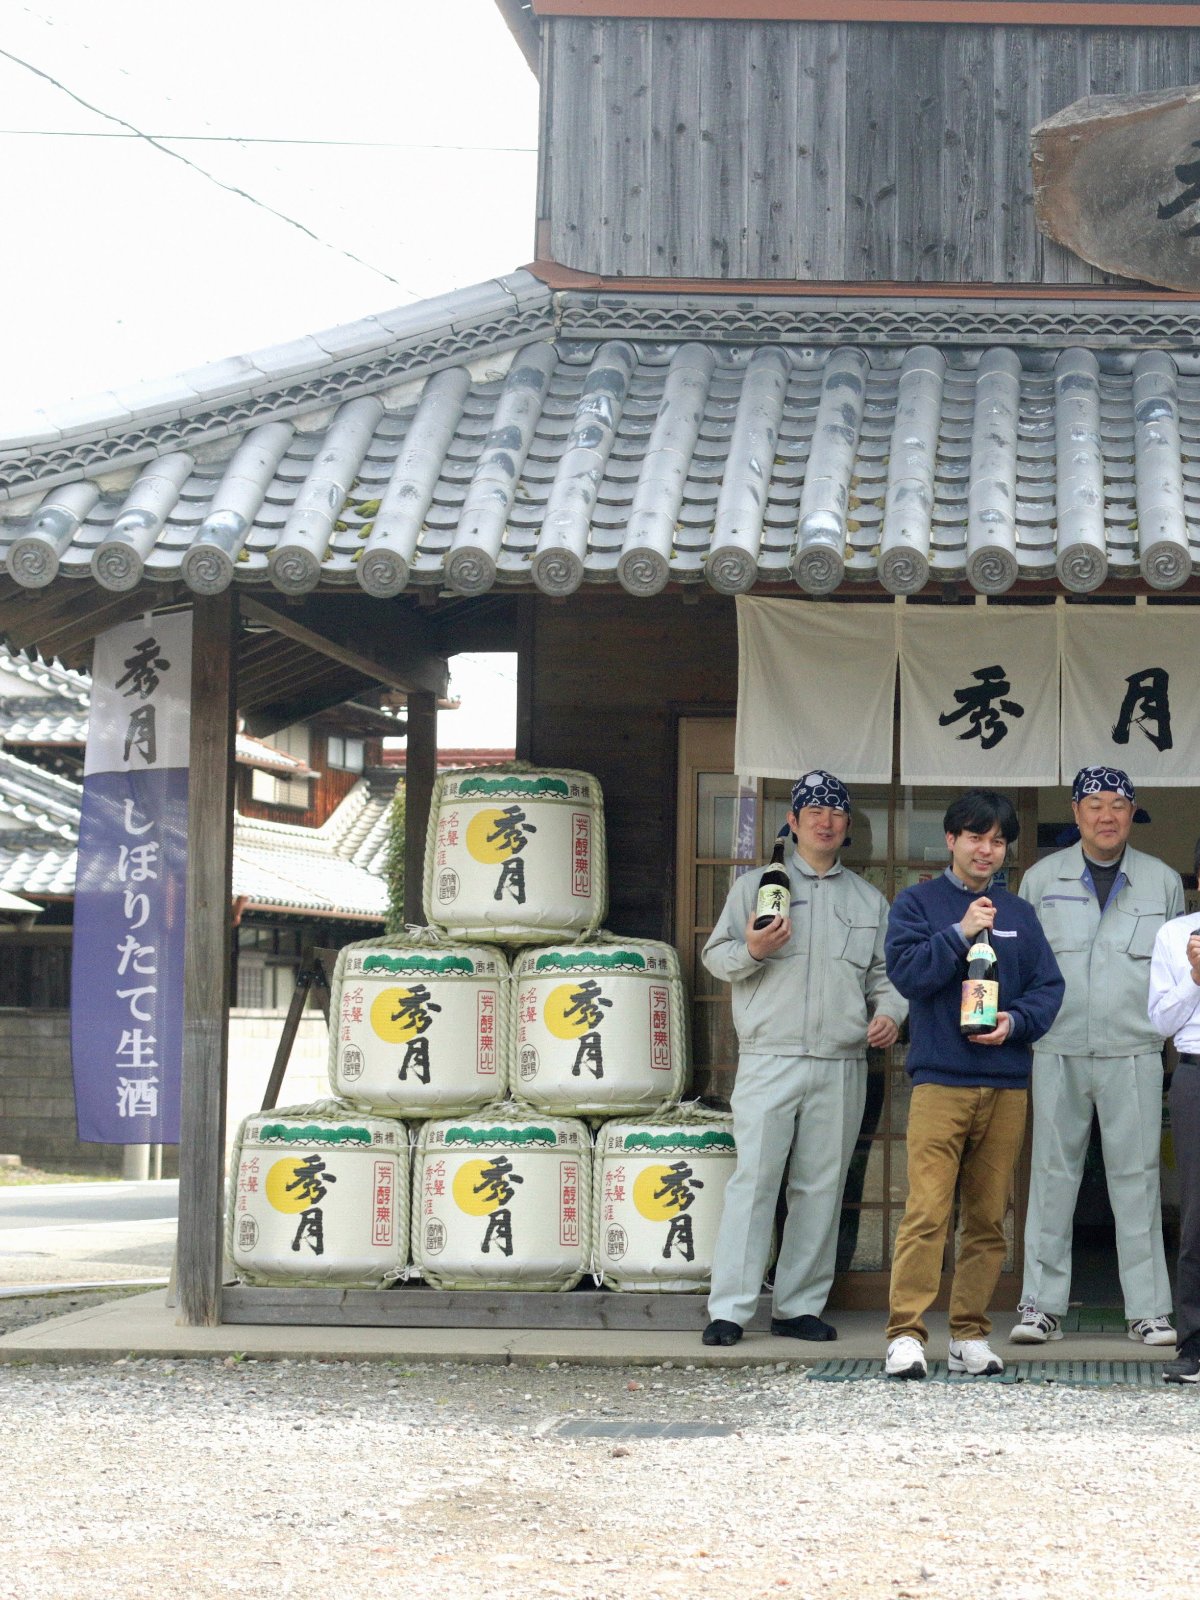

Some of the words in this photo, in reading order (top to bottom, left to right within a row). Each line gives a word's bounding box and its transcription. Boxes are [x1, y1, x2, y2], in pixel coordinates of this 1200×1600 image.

[115, 637, 171, 764] 秀月
[938, 664, 1173, 752] 秀月
[487, 805, 537, 904] 秀月
[770, 889, 785, 912] 秀月
[115, 798, 160, 1118] しぼりたて生酒
[971, 983, 988, 1015] 秀月
[391, 984, 441, 1084] 秀月
[564, 979, 613, 1079] 秀月
[286, 1154, 336, 1255] 秀月
[474, 1155, 523, 1257] 秀月
[654, 1161, 704, 1262] 秀月
